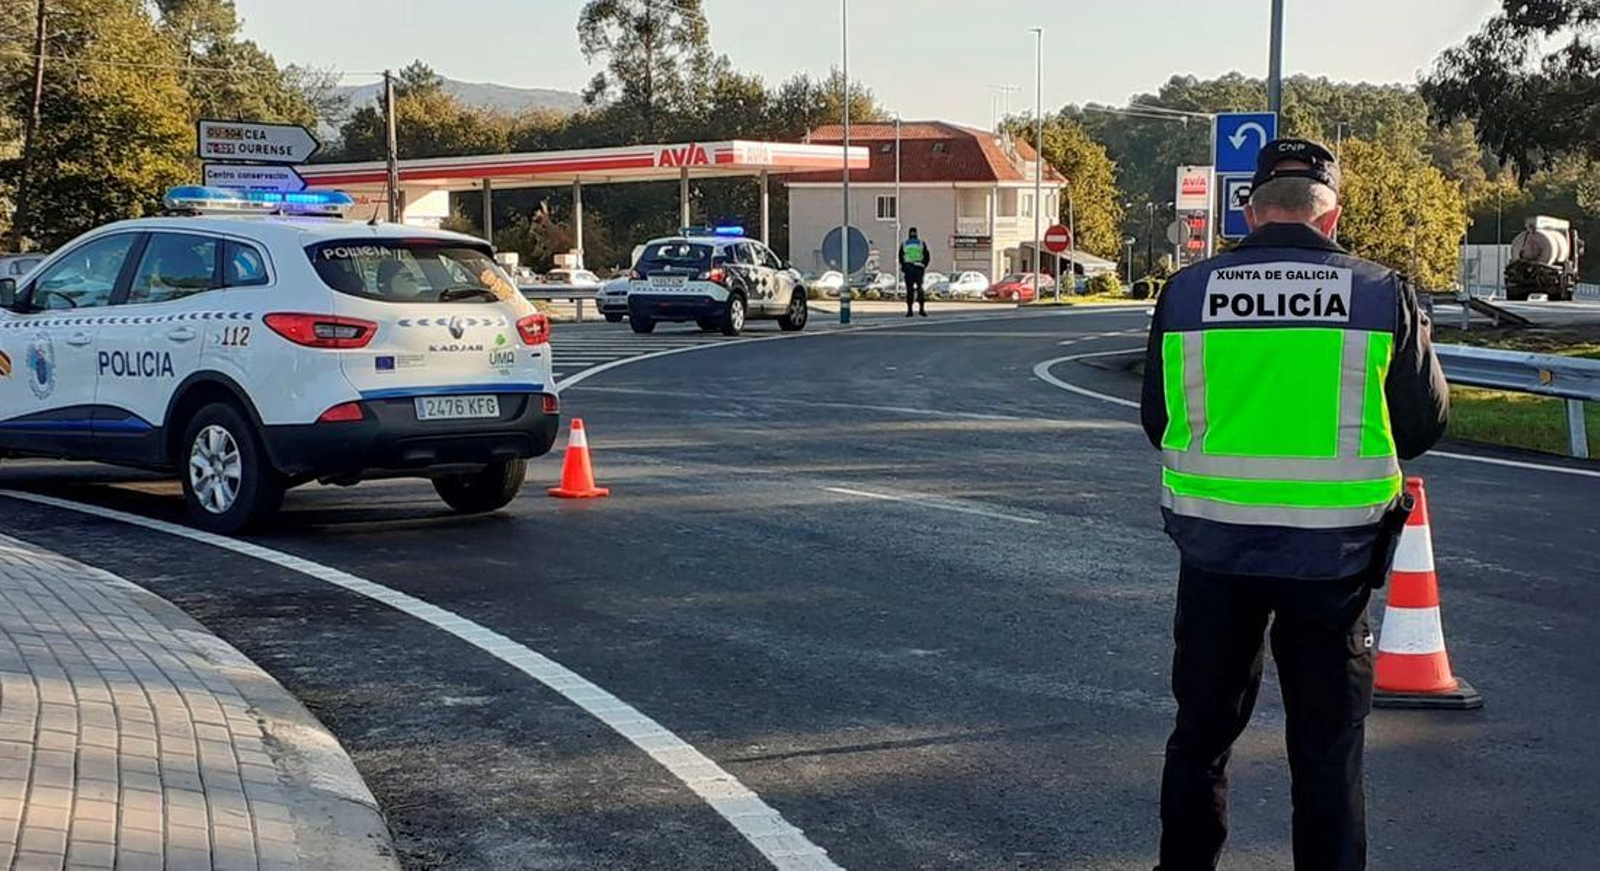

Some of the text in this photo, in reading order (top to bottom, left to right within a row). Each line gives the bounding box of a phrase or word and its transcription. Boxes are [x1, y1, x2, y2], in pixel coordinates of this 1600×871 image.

[245, 130, 267, 140] CEA
[238, 143, 293, 156] OURENSE
[659, 141, 709, 167] AVIA
[1278, 143, 1306, 152] CNP
[207, 170, 235, 179] Centro
[1183, 176, 1206, 187] AVIA
[1217, 270, 1339, 280] XUNTA DE GALICIA
[1210, 288, 1347, 316] POLICÍA
[221, 326, 250, 346] 112
[429, 344, 483, 352] KADJAR
[98, 351, 174, 377] POLICIA
[489, 351, 515, 365] UMA
[426, 398, 496, 416] 2476 KFG
